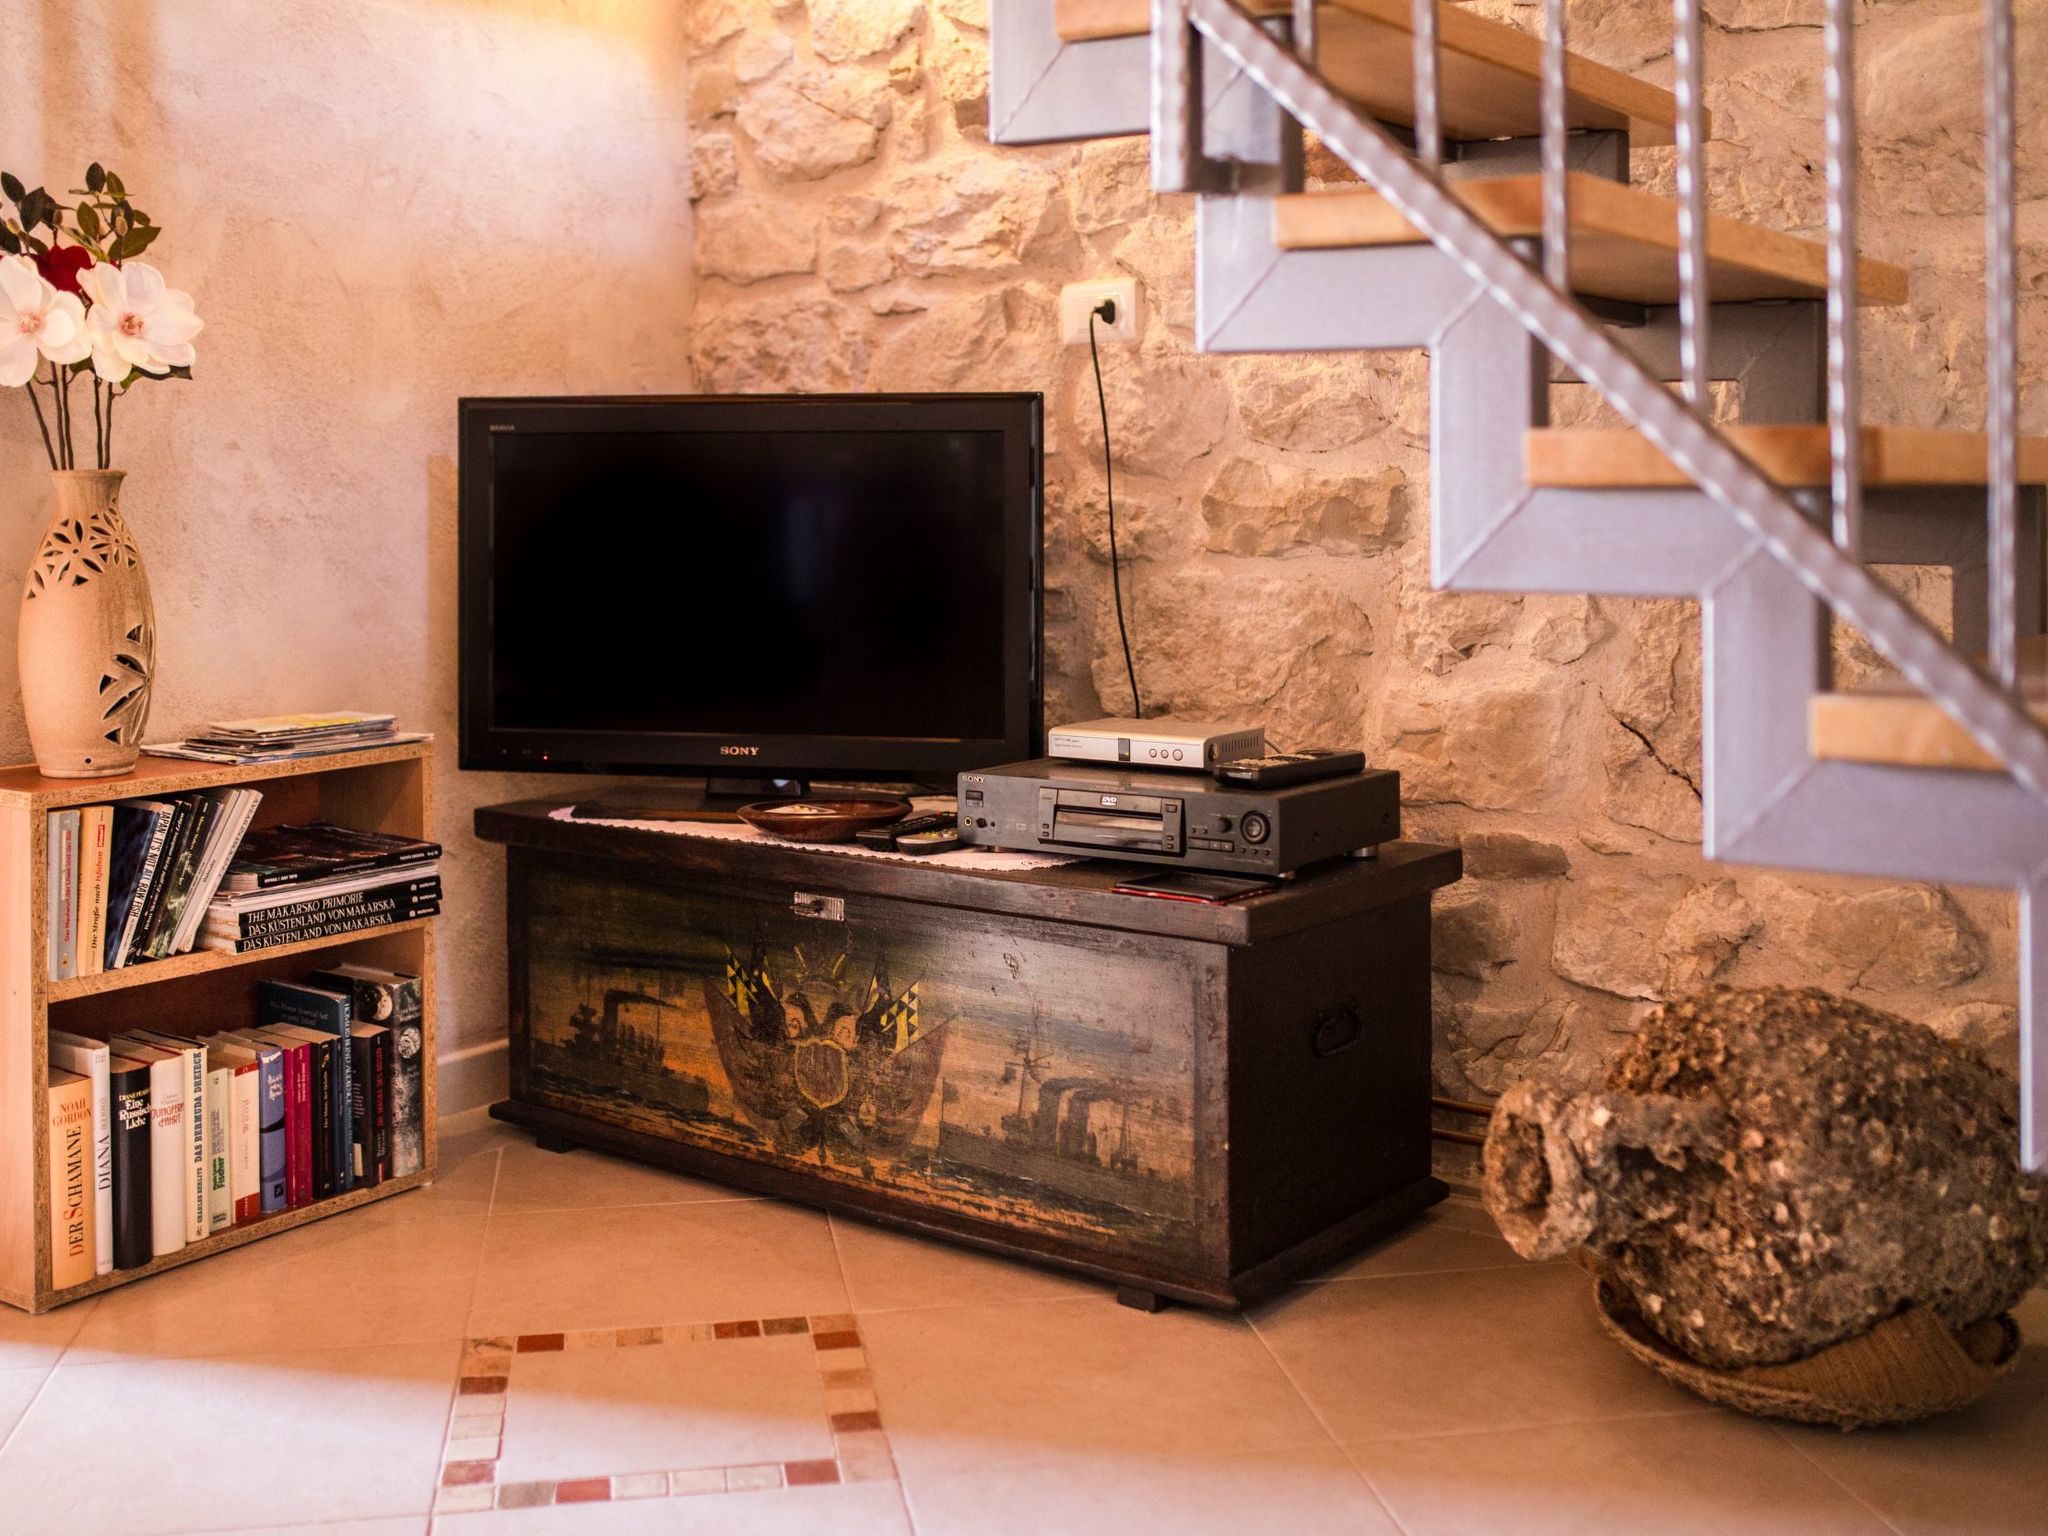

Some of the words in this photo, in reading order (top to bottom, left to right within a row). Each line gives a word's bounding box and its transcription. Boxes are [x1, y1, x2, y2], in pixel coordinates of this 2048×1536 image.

[720, 746, 760, 756] SONY
[961, 775, 985, 783] SONY
[1101, 796, 1118, 804] DVD
[156, 811, 171, 836] JAPAN:
[151, 837, 163, 851] IT'S
[146, 852, 160, 869] NOT
[143, 868, 155, 881] ALL
[137, 882, 150, 899] RAW
[130, 900, 145, 918] FISH
[247, 912, 265, 924] THE
[266, 900, 320, 920] MAKARSKO
[248, 923, 266, 937] DAS
[267, 911, 326, 931] KÜSTENLAND
[327, 908, 345, 921] VON
[344, 899, 396, 918] MAKARSKA
[91, 905, 101, 933] Straße
[243, 937, 262, 952] DAS
[263, 926, 323, 948] KÜSTENLAND
[323, 921, 343, 935] VON
[342, 912, 393, 932] MAKARSKA
[193, 1052, 202, 1093] DREIECK
[59, 1098, 86, 1113] NOAH
[118, 1103, 151, 1121] Russisch
[125, 1098, 144, 1111] Eine
[52, 1108, 91, 1127] GORDON
[125, 1116, 146, 1131] Liebe
[193, 1095, 203, 1142] BERMUDA
[98, 1134, 111, 1191] DIANA
[194, 1144, 203, 1164] DAS
[63, 1126, 83, 1220] SCHAMANE
[216, 1156, 225, 1189] Fischer
[69, 1220, 84, 1257] DER
